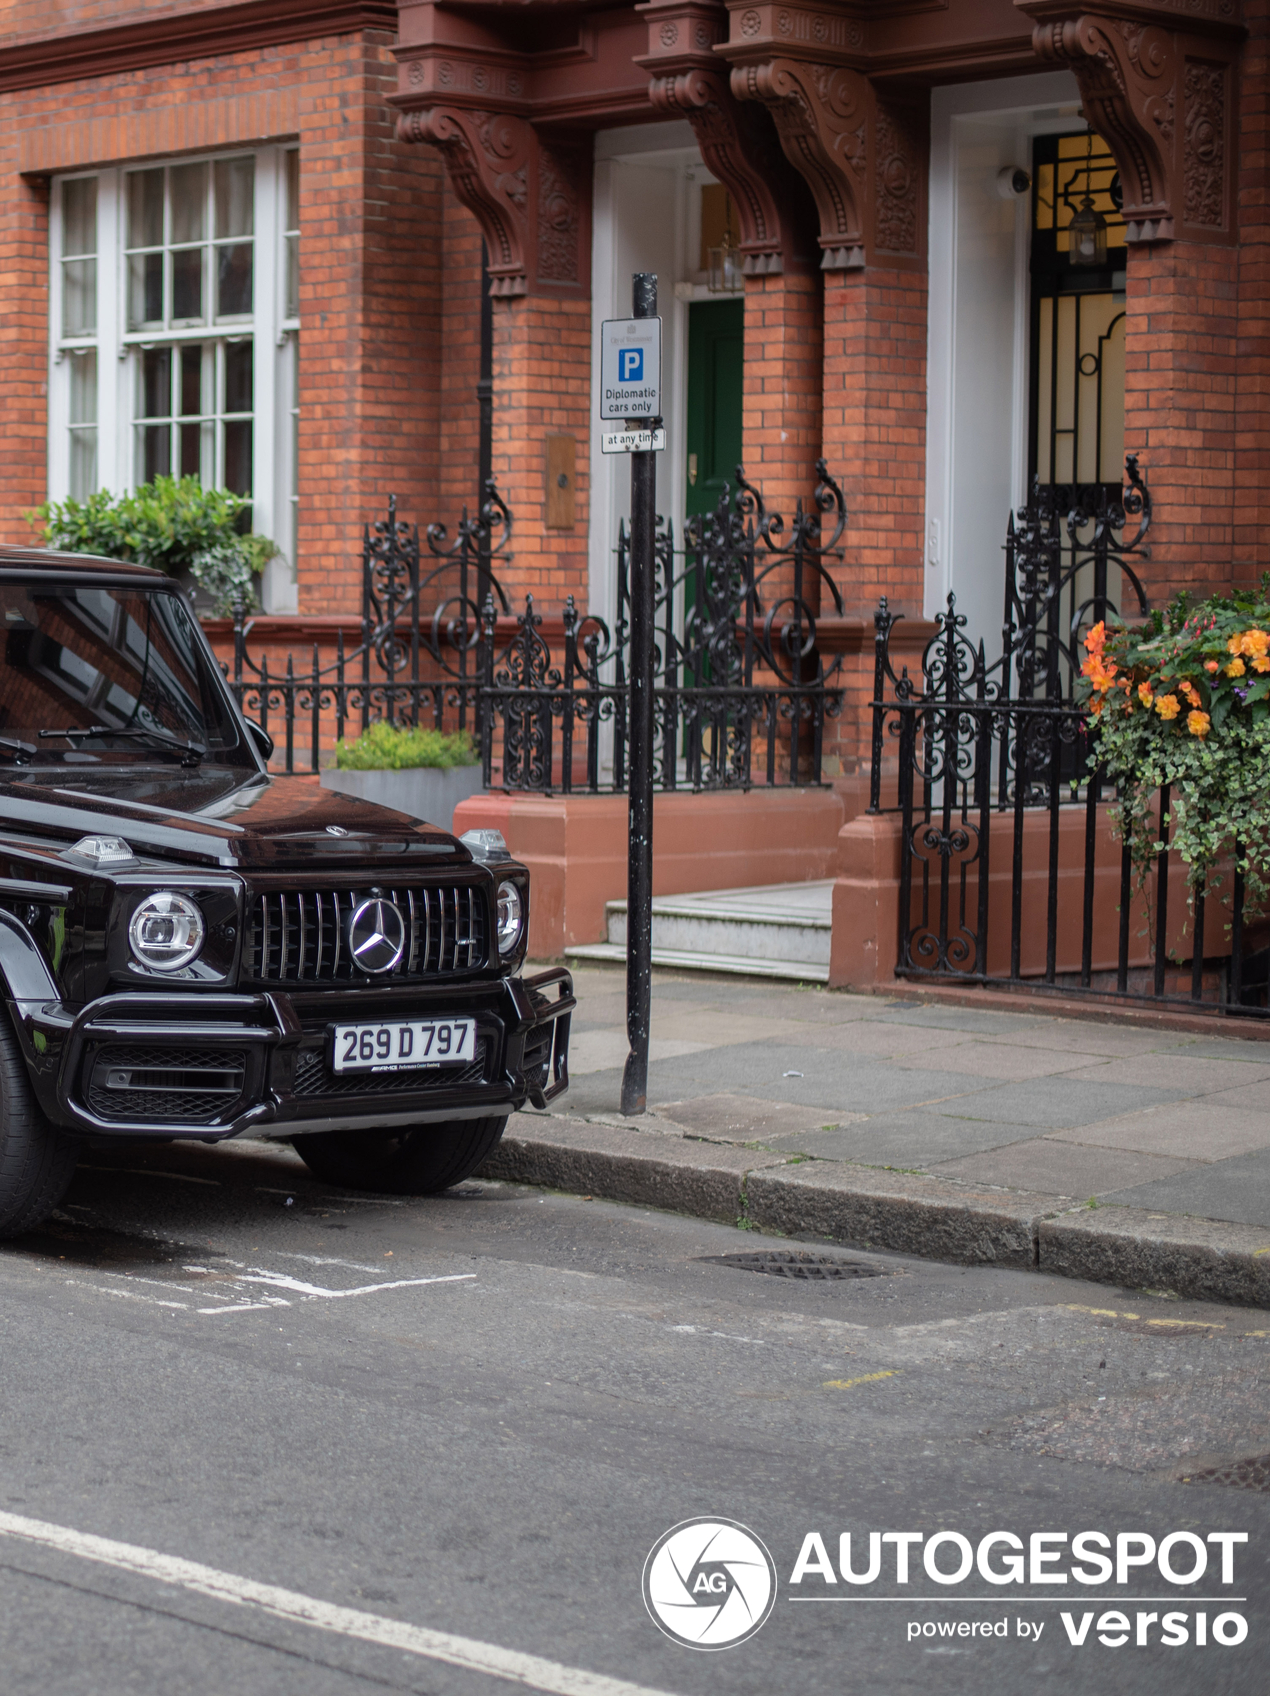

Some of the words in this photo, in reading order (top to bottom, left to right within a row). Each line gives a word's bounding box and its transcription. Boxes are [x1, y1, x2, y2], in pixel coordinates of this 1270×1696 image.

[624, 352, 640, 379] P
[606, 388, 656, 400] Diplomatic
[609, 403, 629, 412] cars
[631, 401, 652, 412] only
[608, 435, 617, 444] at
[619, 435, 636, 444] any
[342, 1029, 391, 1062] 269
[398, 1027, 413, 1058] D
[421, 1023, 468, 1056] 797
